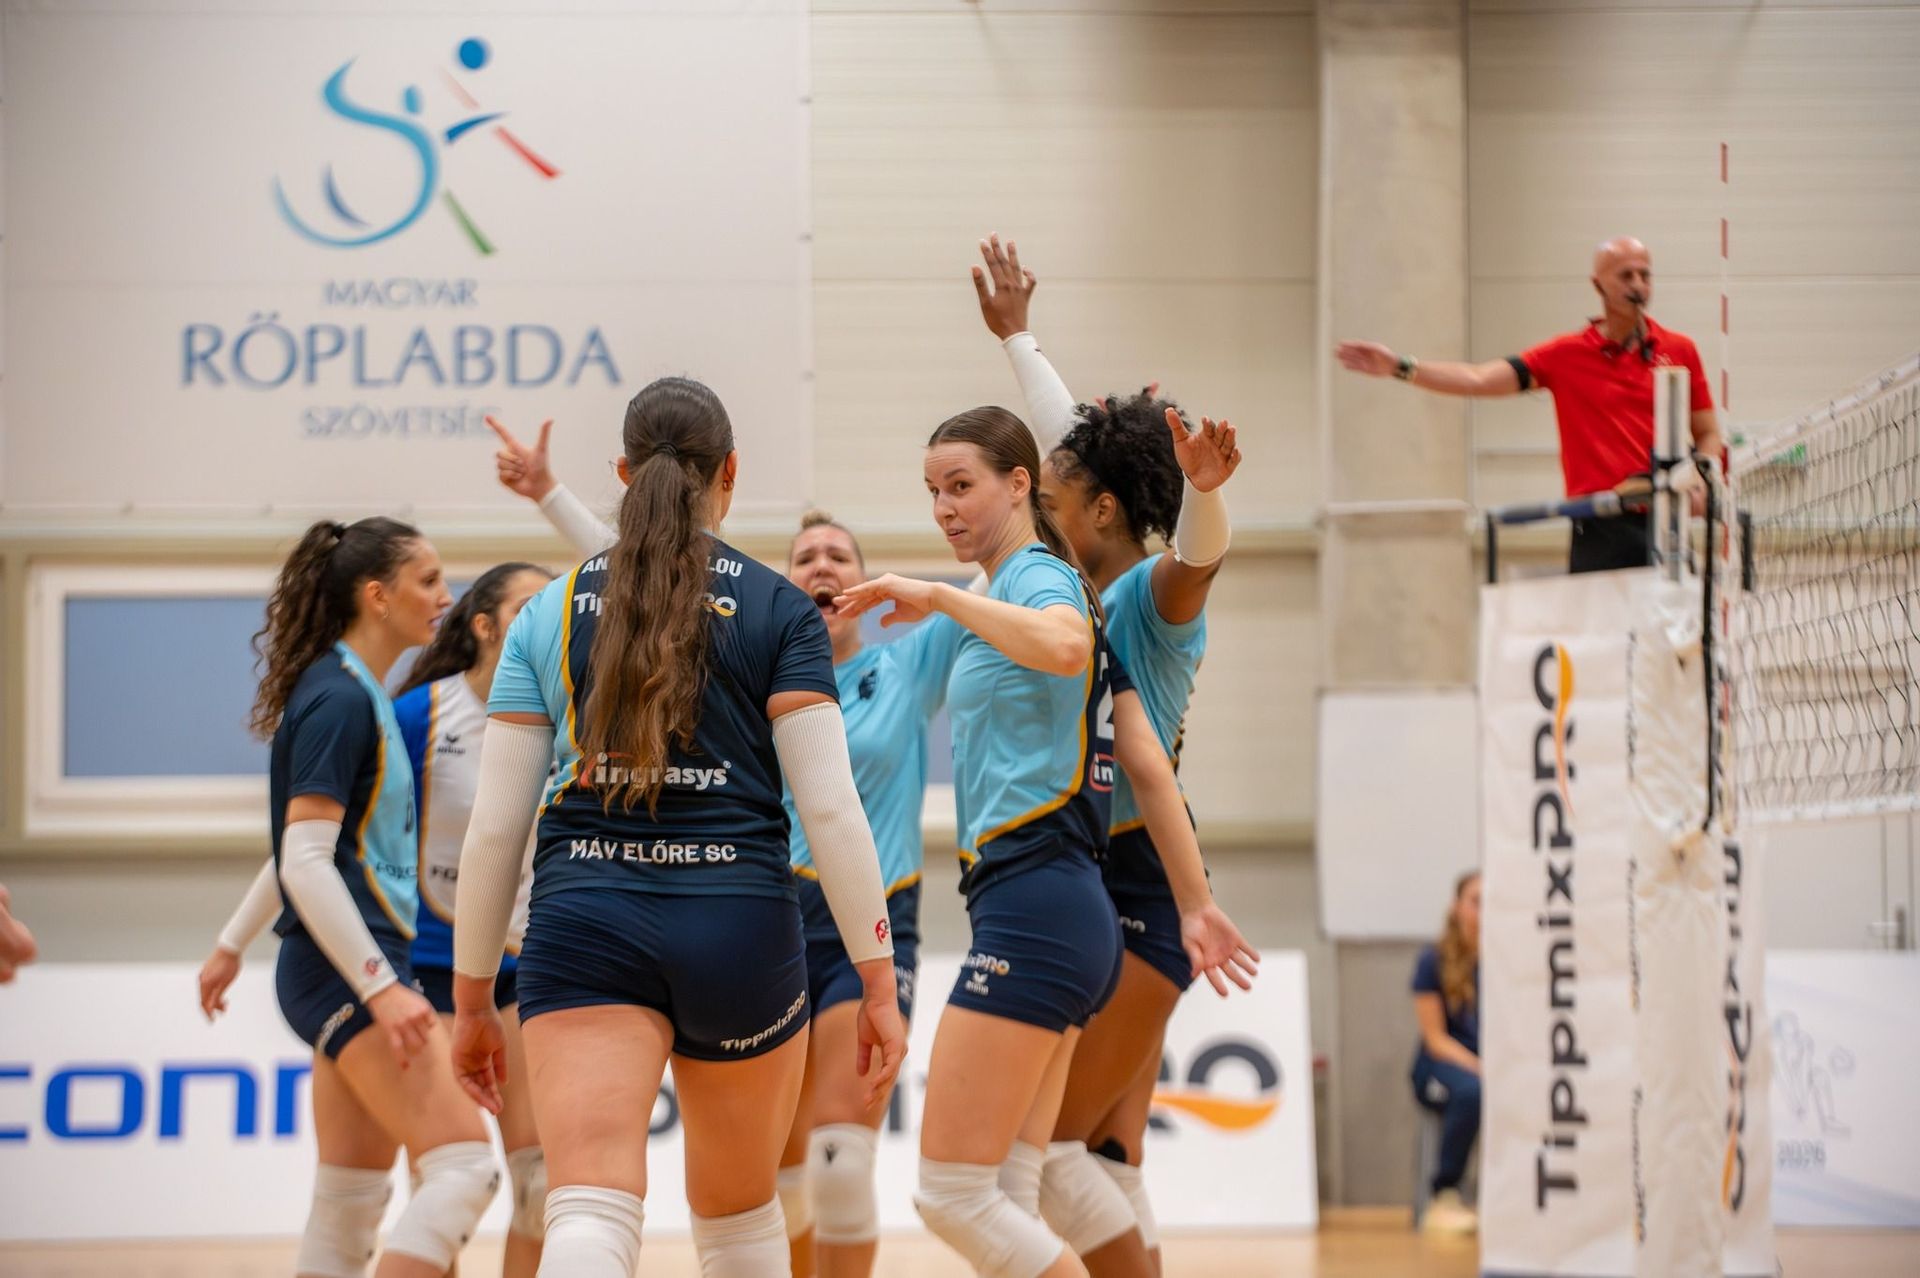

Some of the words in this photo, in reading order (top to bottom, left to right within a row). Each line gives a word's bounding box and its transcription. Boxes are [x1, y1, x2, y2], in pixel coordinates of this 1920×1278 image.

[324, 278, 478, 307] MAGYAR
[181, 310, 623, 391] RÖPLABDA
[569, 837, 618, 860] MÁV
[623, 839, 700, 865] ELŐRE
[704, 844, 737, 863] SC
[1532, 642, 1588, 1211] TippmixPRO
